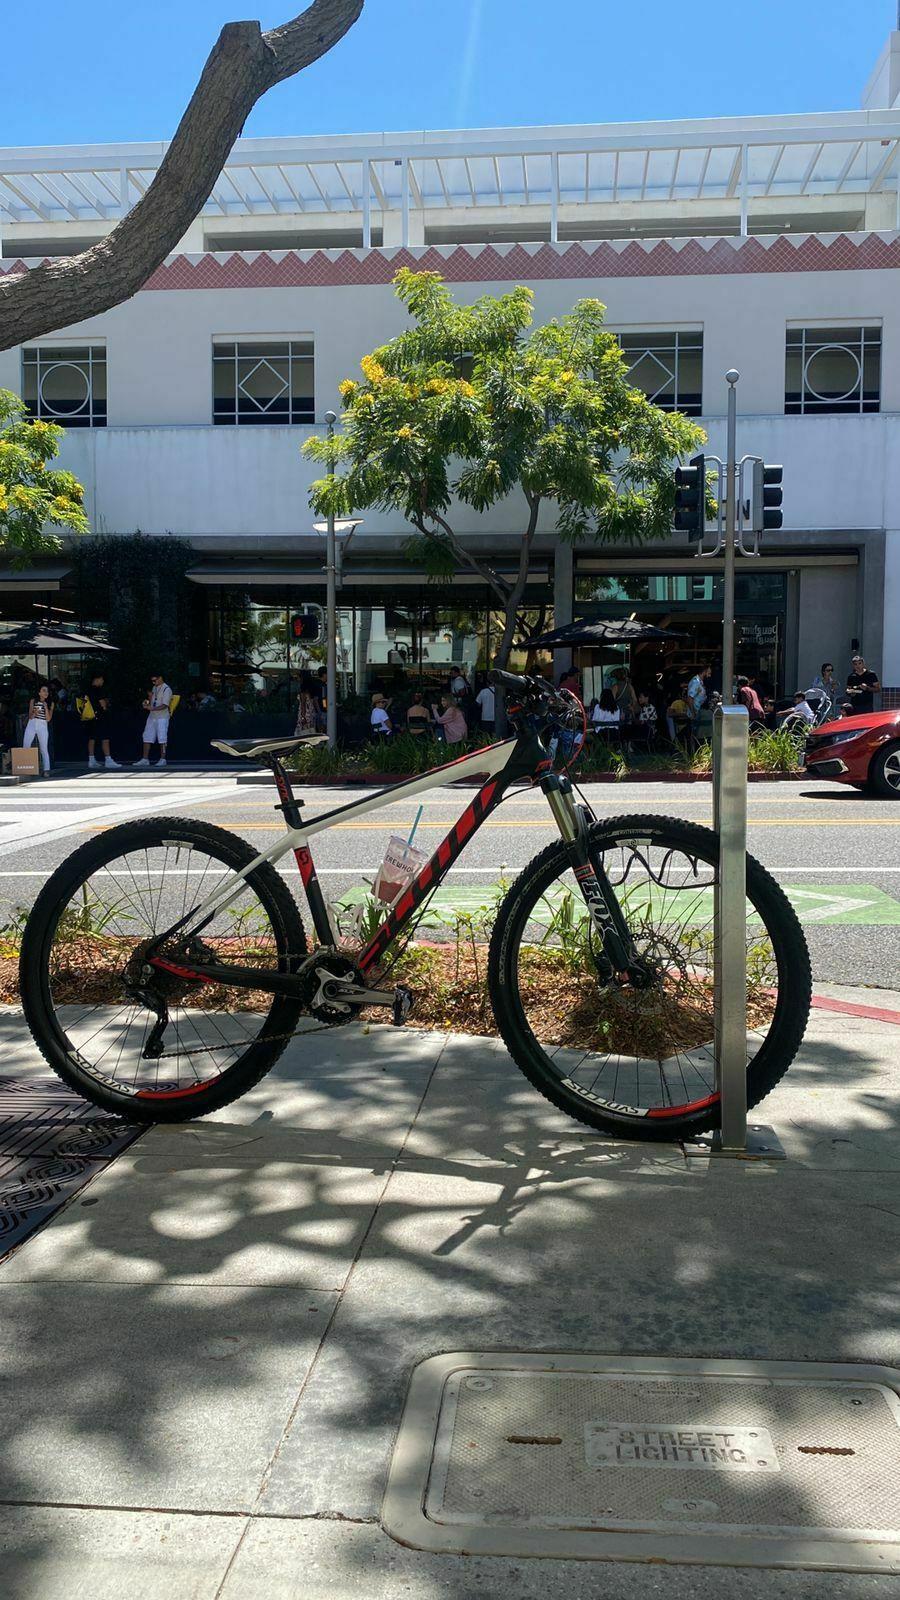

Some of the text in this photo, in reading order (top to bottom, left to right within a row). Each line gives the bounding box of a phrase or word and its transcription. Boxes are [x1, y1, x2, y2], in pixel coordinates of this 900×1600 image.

[385, 854, 414, 873] EREWHO
[581, 881, 620, 941] FOX
[72, 1053, 131, 1094] SYNCROS
[565, 1080, 639, 1115] SYNCROS
[619, 1430, 735, 1447] STREET
[615, 1445, 747, 1463] LIGHTING
